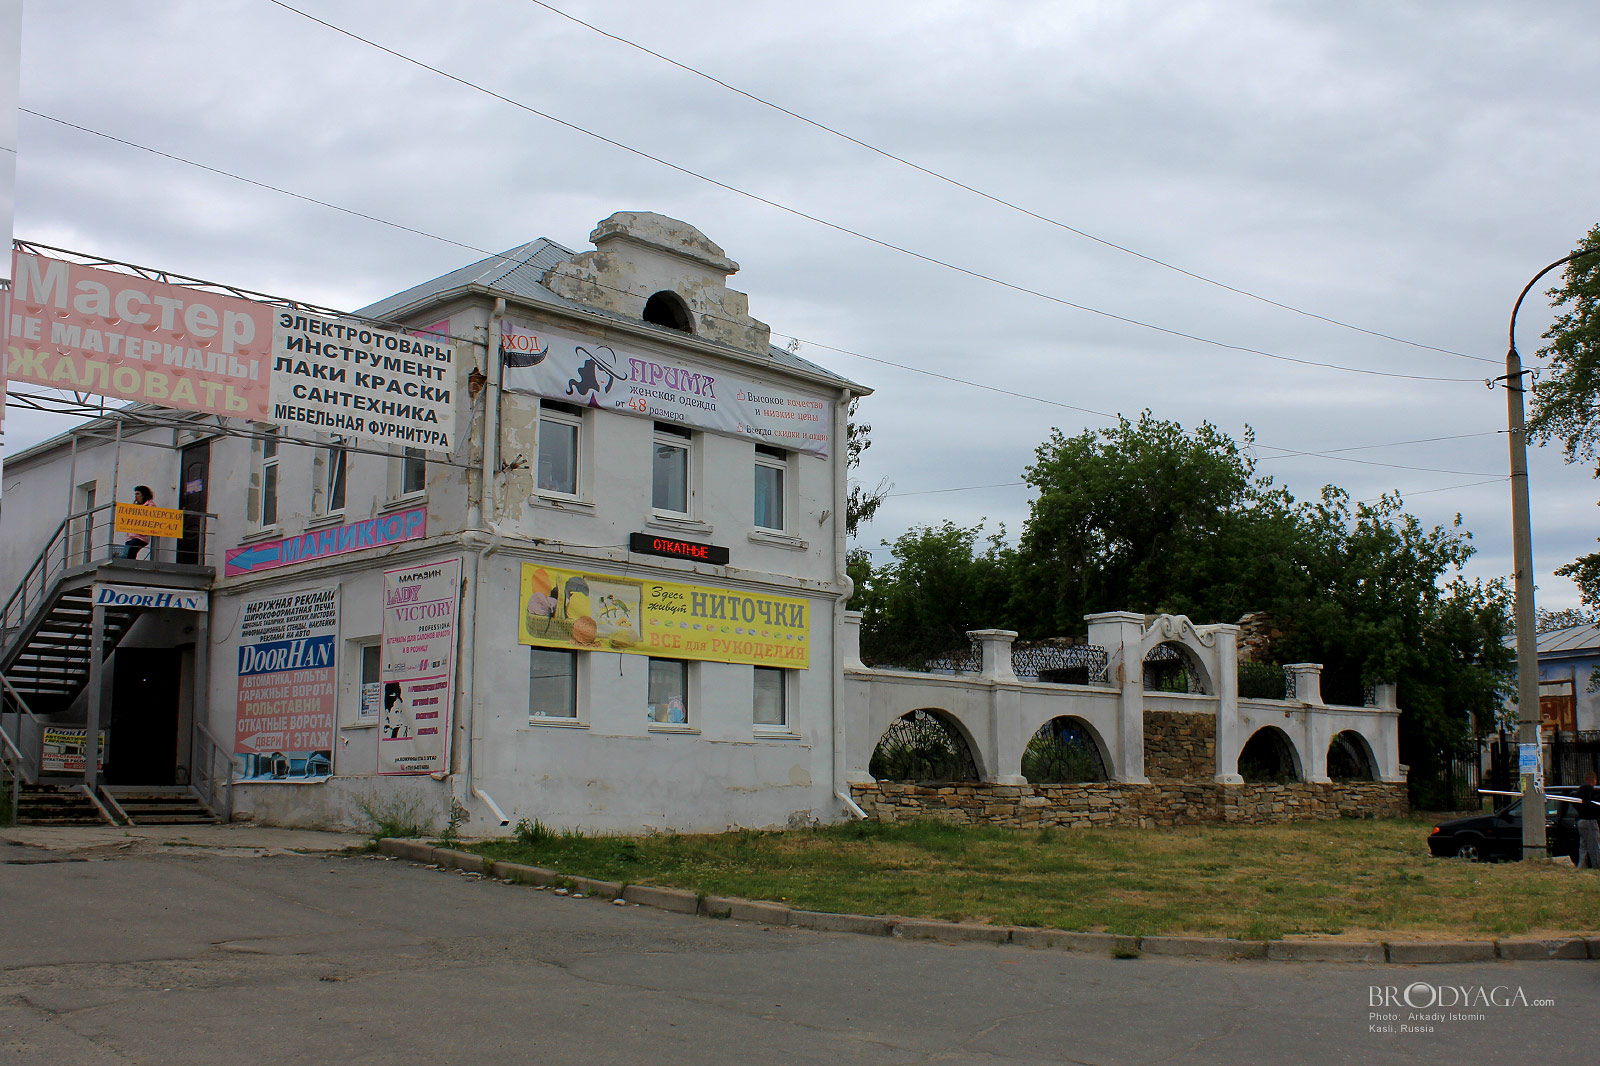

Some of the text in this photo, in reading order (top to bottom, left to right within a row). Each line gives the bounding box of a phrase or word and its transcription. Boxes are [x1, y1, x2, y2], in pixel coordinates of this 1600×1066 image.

[14, 252, 257, 354] Мастер
[279, 313, 452, 363] ЭЛЕКТРОТОВАРЫ
[51, 321, 260, 380] МАТЕРИАЛЫ
[286, 336, 447, 381] ИНСТРУМЕНТ
[273, 356, 451, 404] ЛАКИ КРАСКИ
[628, 357, 717, 400] ПРИМА
[292, 384, 439, 424] САНТЕХНИКА
[628, 396, 647, 413] 48
[648, 406, 686, 421] размера
[629, 385, 717, 412] женская одежда
[747, 391, 824, 410] Высокое качество
[274, 403, 450, 447] МЕБЕЛЬНАЯ ФУРНИТУРА
[754, 408, 820, 422] и низкие цены
[773, 429, 801, 439] скидки
[118, 506, 183, 521] ПАРИКМАХЕРСКАЯ
[120, 517, 178, 531] УНИВЕРСАЛ
[281, 510, 424, 564] МАНИКЮР
[652, 538, 710, 559] ОТКАТНЫЕ
[399, 569, 442, 583] МАГАЗИН
[386, 585, 422, 606] LADY
[651, 586, 684, 601] Здесь
[243, 601, 336, 623] ШИРОКОФОРМАТНАЯ ПЕЧАТ
[246, 596, 294, 614] НАРУЖНАЯ
[396, 600, 453, 622] VICTORY
[647, 602, 687, 615] живут
[690, 591, 805, 629] НИТОЧКИ
[259, 632, 286, 643] РЕКЛАМА
[294, 628, 312, 638] АВТО
[418, 621, 451, 632] PROFESSIONA
[650, 632, 805, 661] ВСЕ для РУКОДЕЛИЯ
[293, 669, 329, 683] ПУЛЬТЫ
[239, 682, 333, 702] ГАРАЖНЫЕ ВОРОТА
[245, 697, 321, 717] РОЛЬСТАВНИ
[238, 713, 333, 733] ОТКАТНЫЕ ВОРОТА
[255, 731, 330, 749] ДВЕРИ 1 ЭТАЖ
